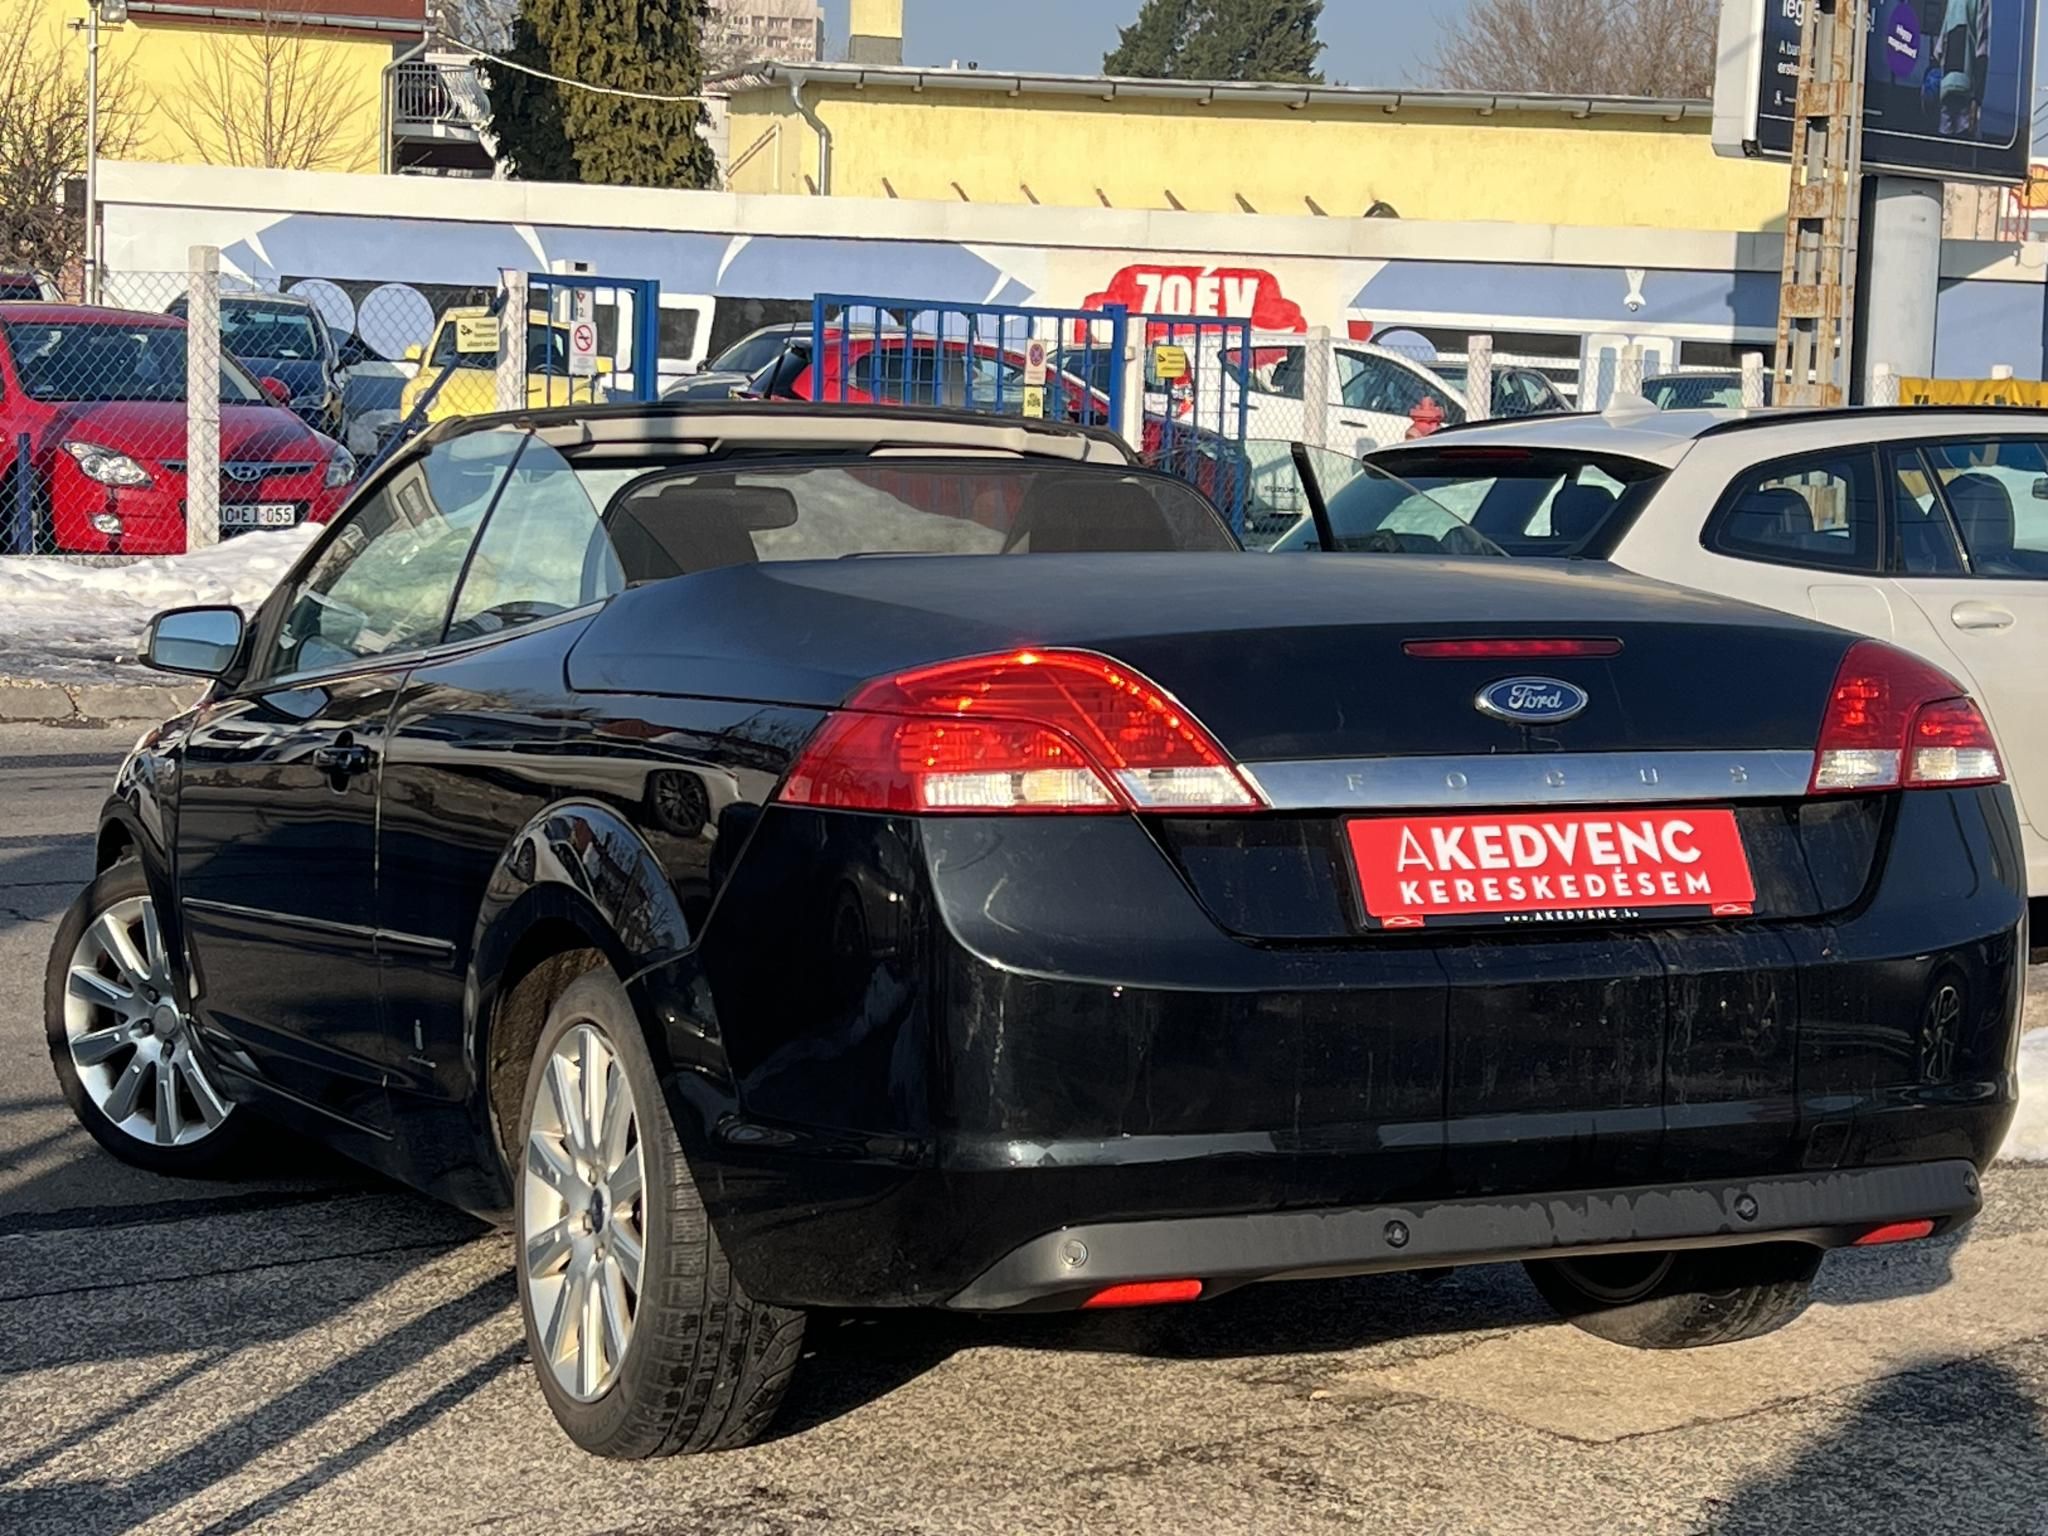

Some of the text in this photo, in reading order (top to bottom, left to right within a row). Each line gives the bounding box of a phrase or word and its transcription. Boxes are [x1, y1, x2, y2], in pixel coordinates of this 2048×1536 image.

[1507, 685, 1562, 709] Ford
[1347, 764, 1749, 792] FOCUS
[1400, 866, 1712, 905] KERESKEDÉSEM
